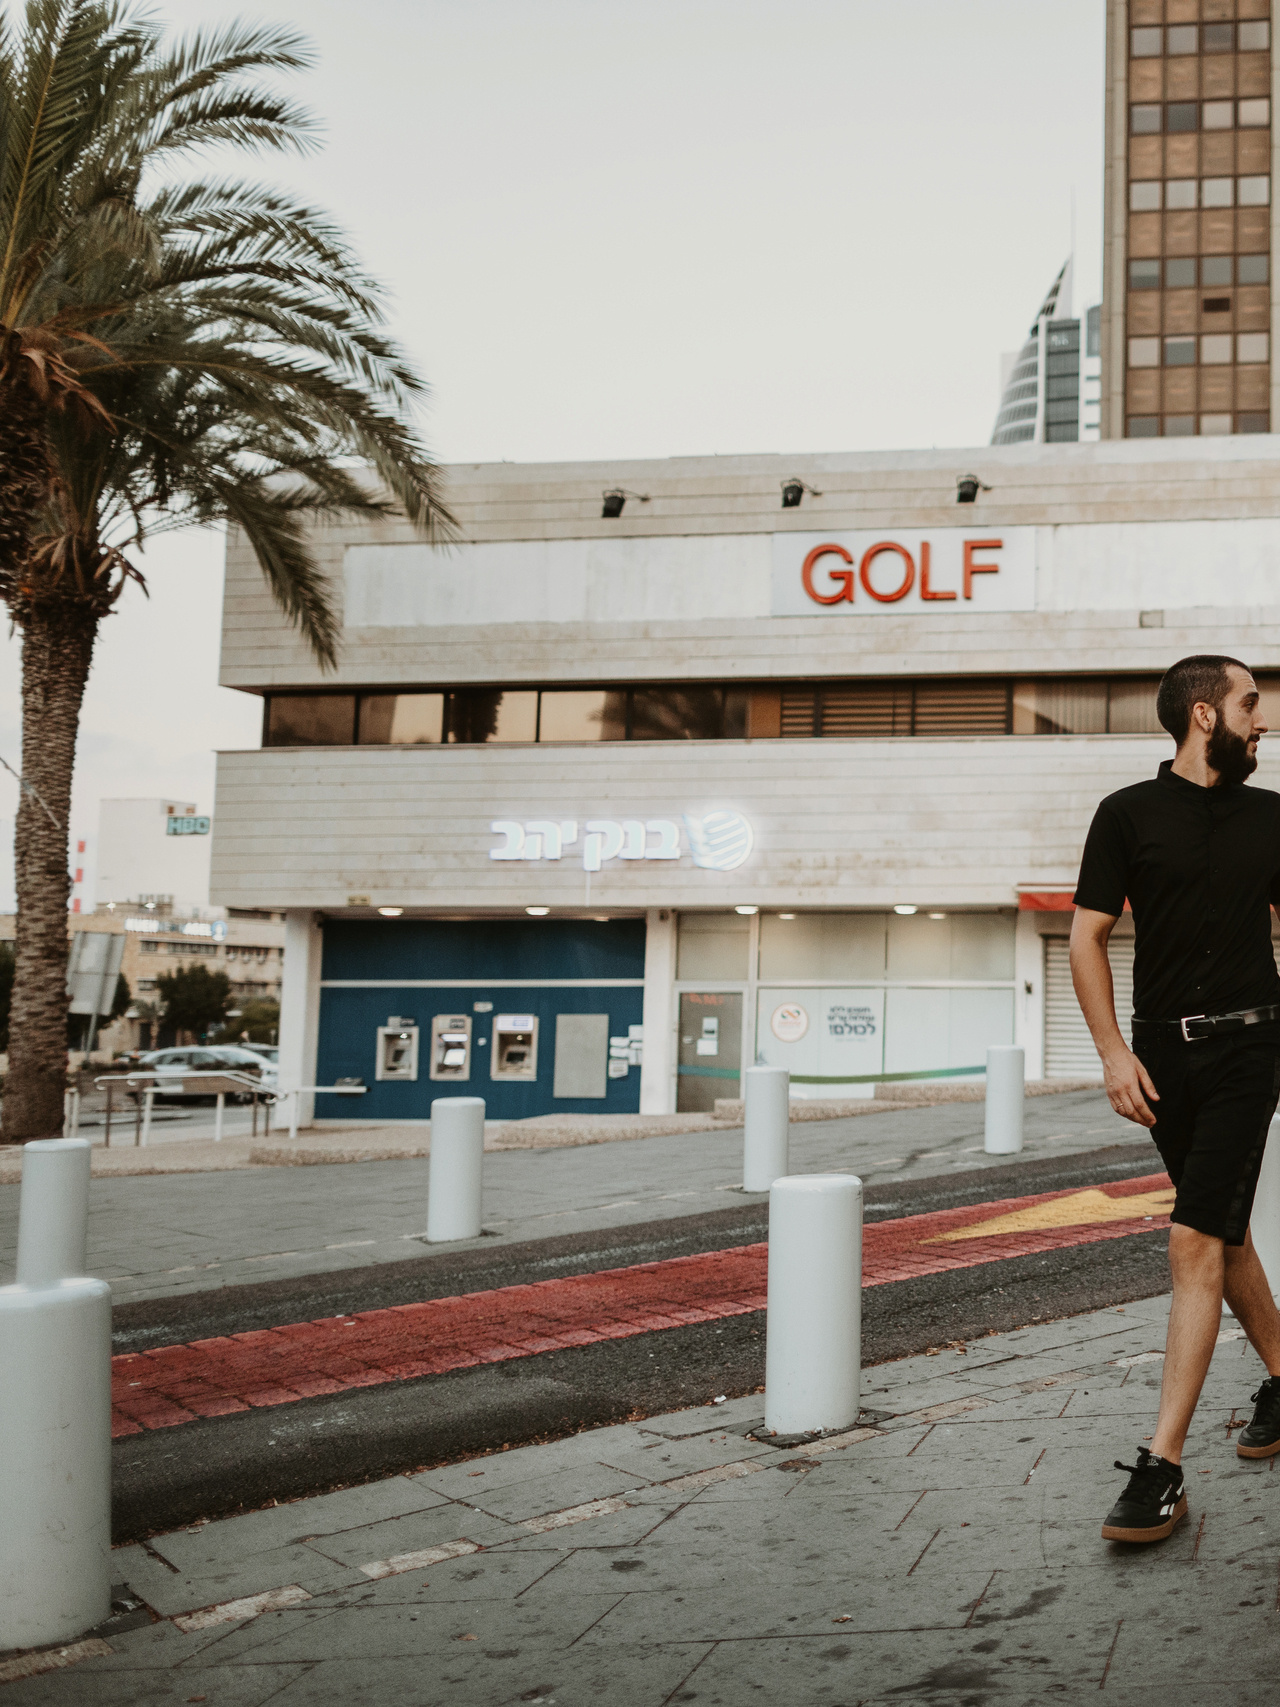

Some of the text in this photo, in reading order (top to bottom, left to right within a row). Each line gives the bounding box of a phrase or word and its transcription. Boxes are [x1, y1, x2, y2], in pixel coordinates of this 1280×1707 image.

[802, 538, 1003, 606] GOLF
[489, 819, 681, 871] בנק יהב
